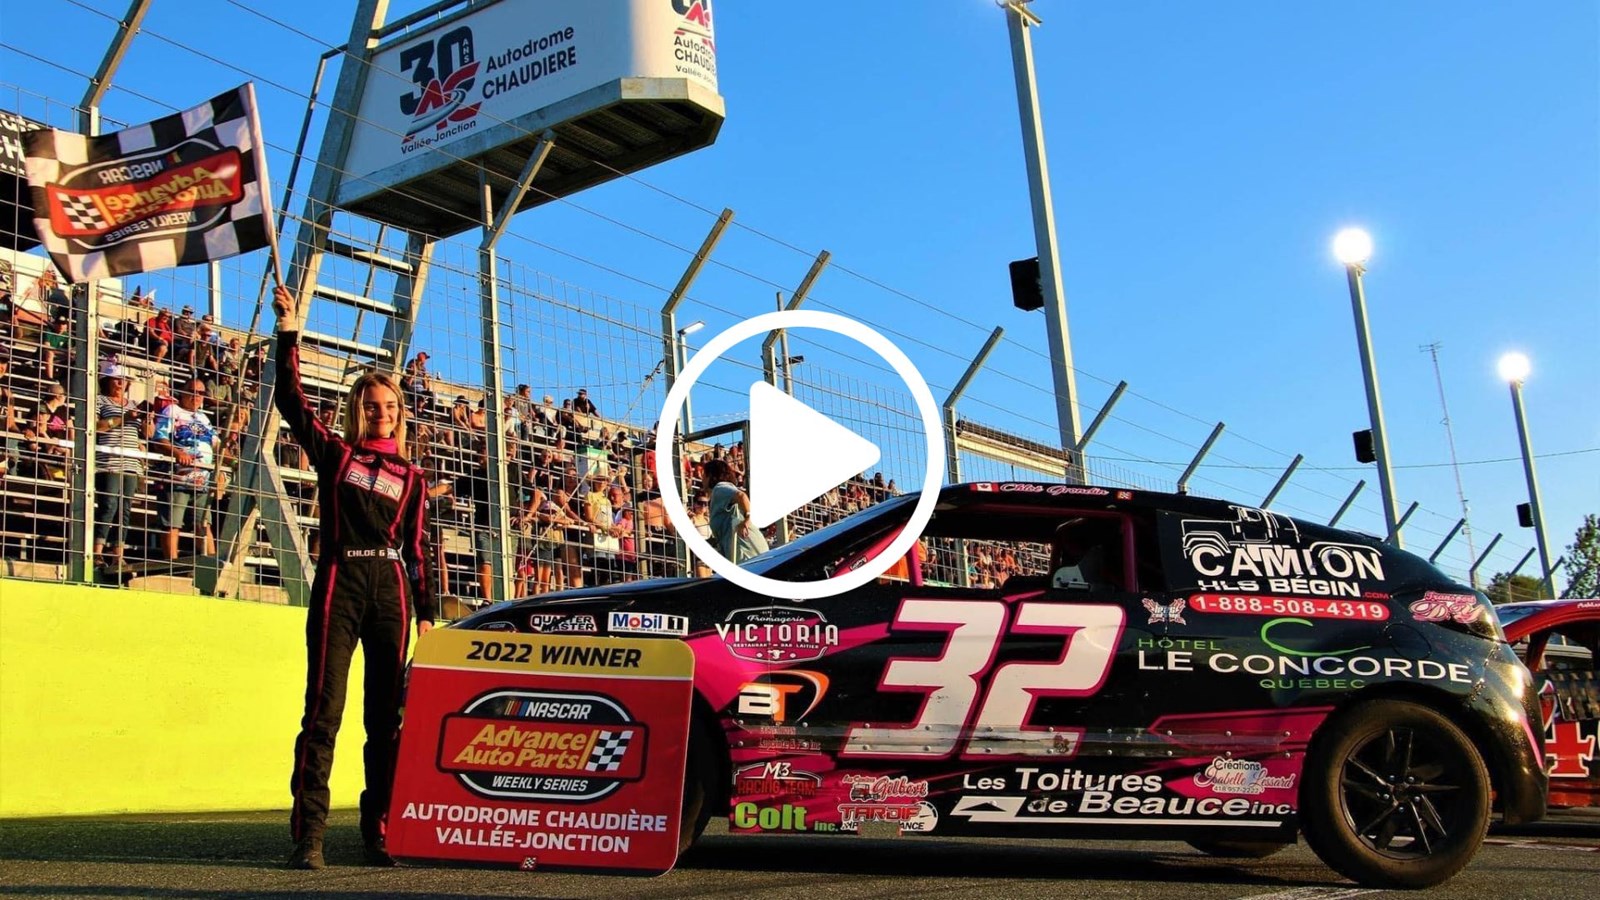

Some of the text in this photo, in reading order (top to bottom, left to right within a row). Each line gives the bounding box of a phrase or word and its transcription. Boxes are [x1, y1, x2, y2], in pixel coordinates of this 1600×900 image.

[462, 38, 470, 63] ANS
[486, 27, 574, 73] Autodrome
[400, 26, 475, 115] 30
[482, 45, 577, 99] CHAUDIERE
[400, 120, 477, 154] Vallée-Jonction
[347, 549, 376, 557] CHLOE
[1191, 547, 1385, 581] CAMION
[1269, 575, 1361, 598] BÉGIN
[747, 614, 805, 623] Fromagerie
[1195, 596, 1384, 618] 1-888-508-4319
[613, 613, 662, 629] Mobil
[715, 623, 838, 645] VICTORIA
[466, 641, 642, 668] 2022 WINNER
[1138, 650, 1474, 684] LE CONCORDE
[842, 598, 1126, 758] 32
[525, 701, 592, 720] NASCAR
[470, 724, 587, 751] Advance
[453, 745, 579, 770] Auto Parts
[1214, 758, 1260, 770] Créations
[492, 775, 588, 792] WEEKLY SERIES
[761, 762, 793, 780] M3
[963, 767, 1163, 793] Les Toitures
[738, 780, 818, 796] RACING TEAM
[872, 776, 928, 800] Gilbert
[839, 805, 921, 821] TARDIF
[1027, 791, 1297, 815] de Beauce inc.
[402, 802, 667, 833] AUTODROME CHAUDIÈRE
[735, 802, 807, 830] Colt
[814, 821, 839, 832] inc.
[436, 825, 629, 853] VALLÉE-JONCTION
